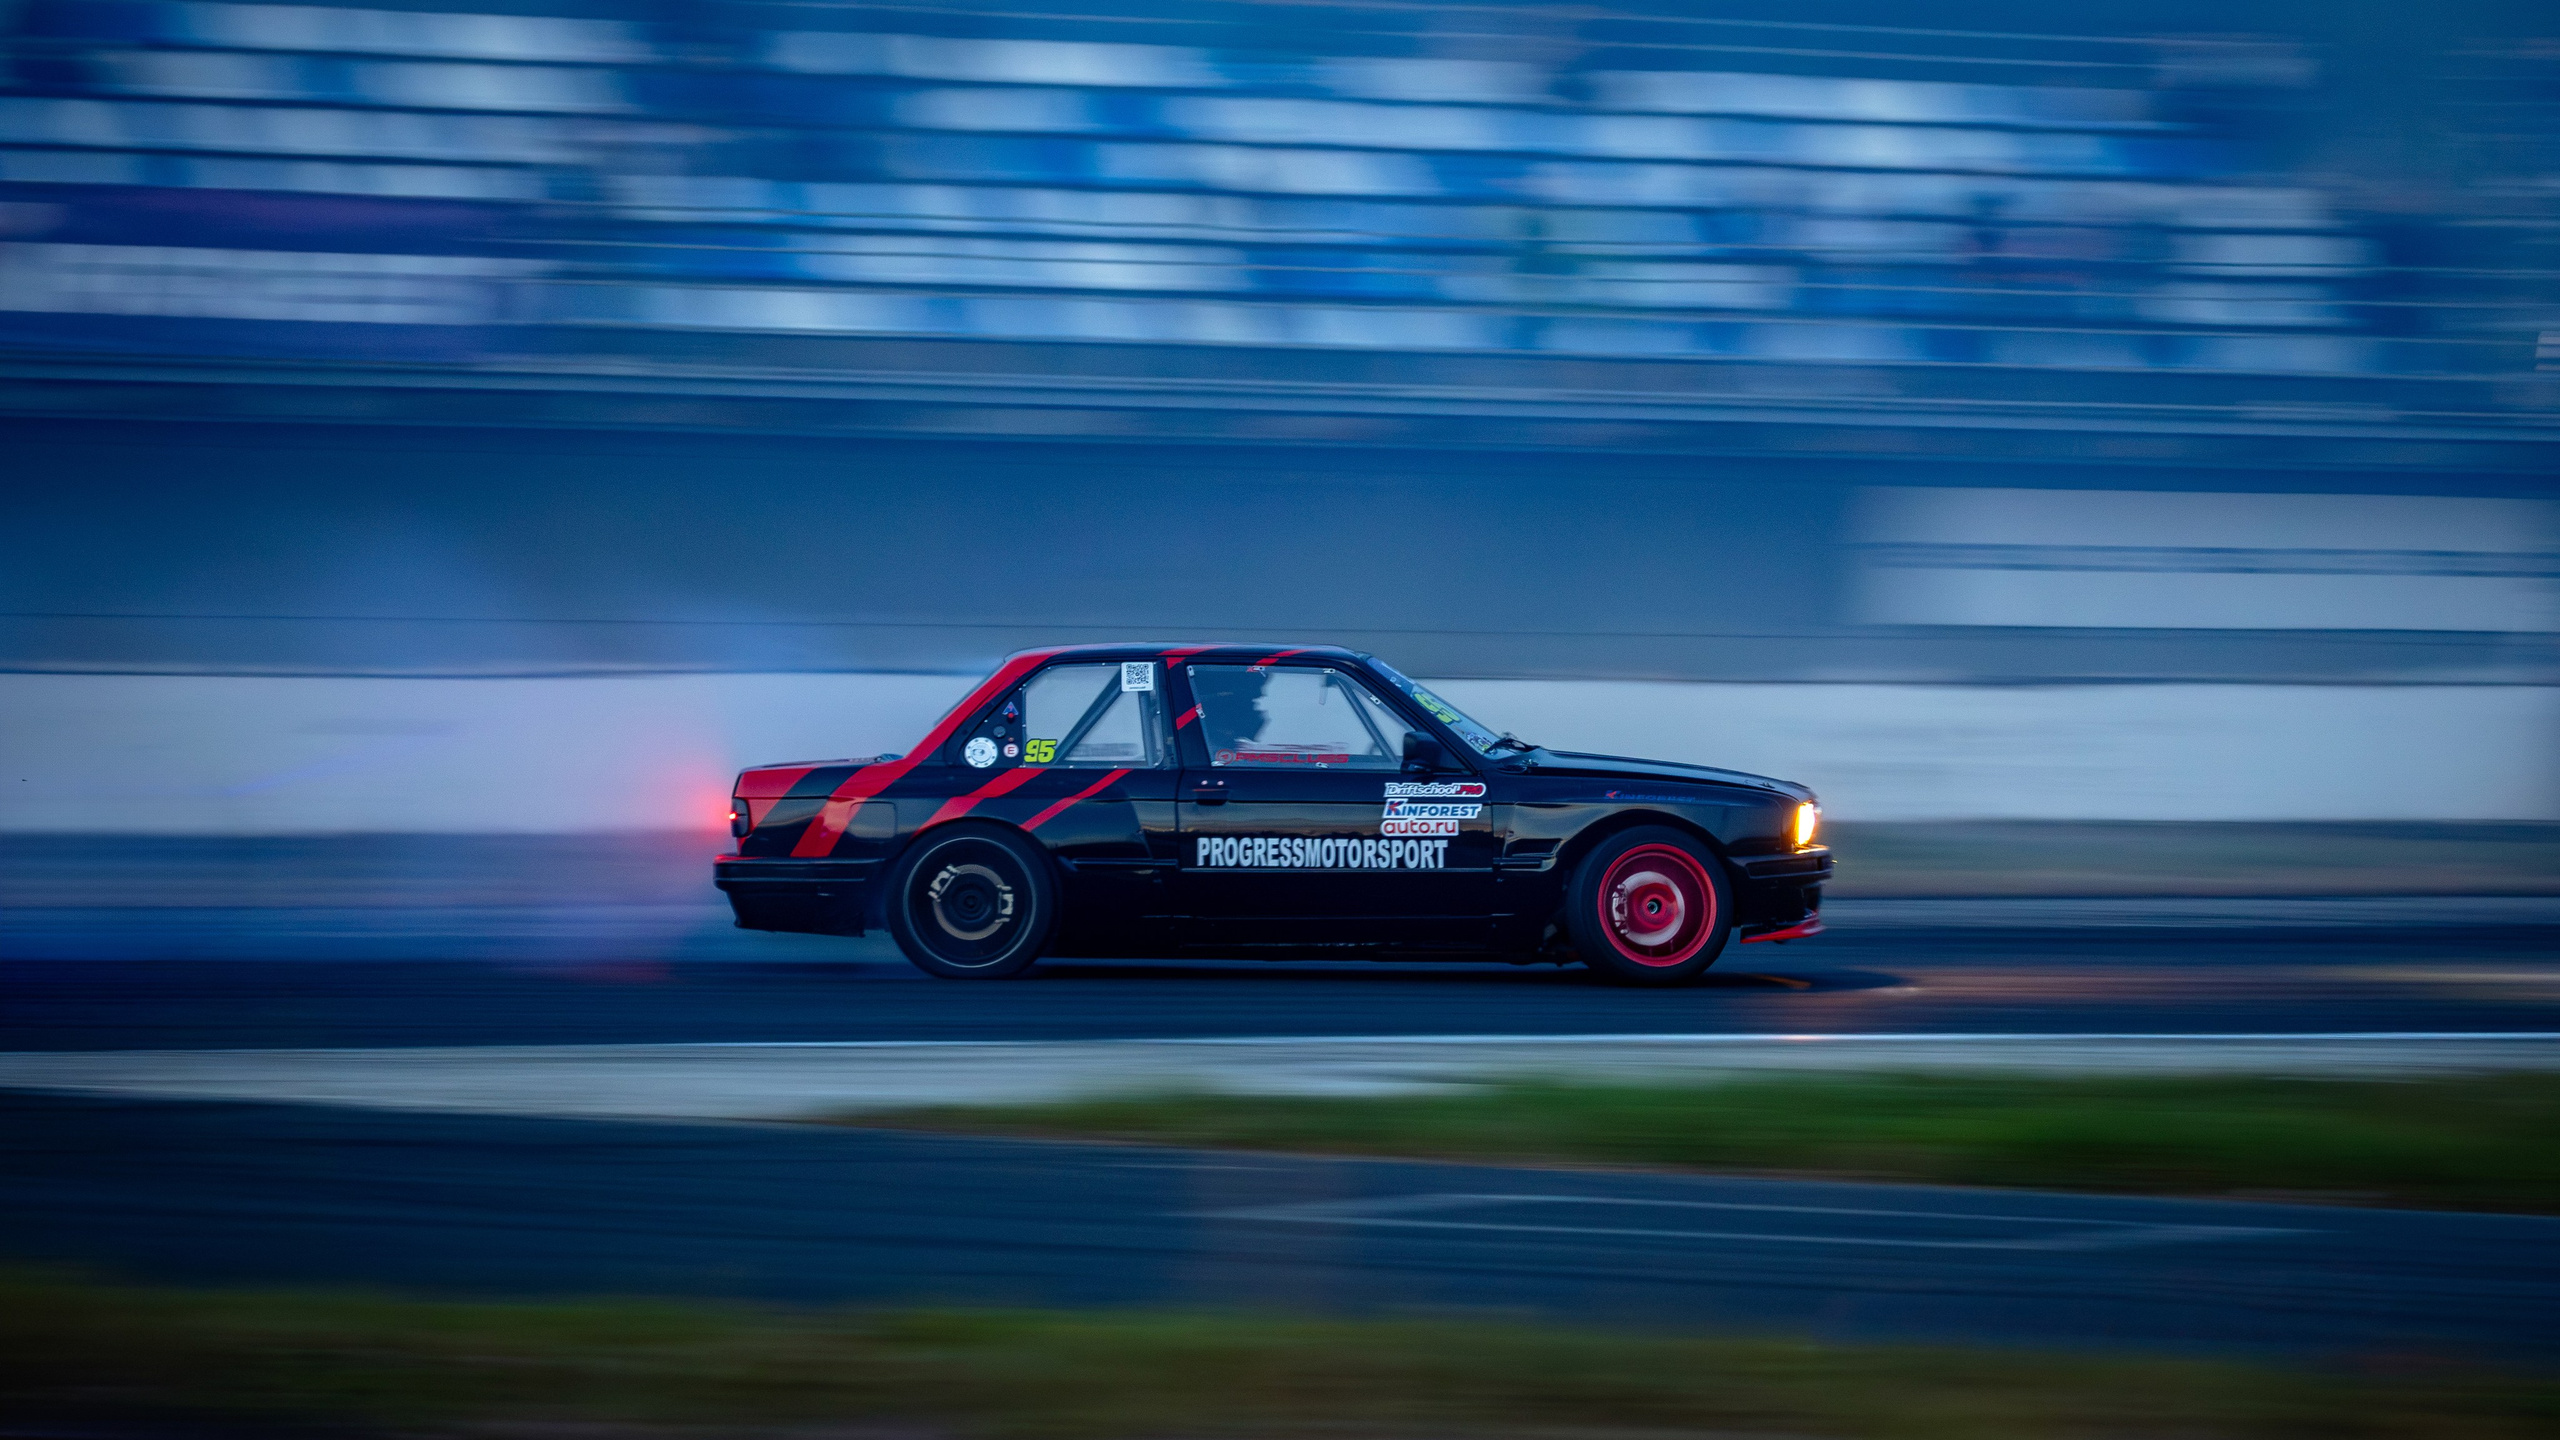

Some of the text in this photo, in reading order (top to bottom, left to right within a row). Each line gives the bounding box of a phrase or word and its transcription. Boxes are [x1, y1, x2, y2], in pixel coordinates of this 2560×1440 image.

[1007, 746, 1015, 755] E
[1023, 738, 1057, 763] 95
[1385, 800, 1480, 817] KINFOREST
[1383, 820, 1456, 834] auto.ru
[1197, 837, 1448, 869] PROGRESSMOTORSPORT
